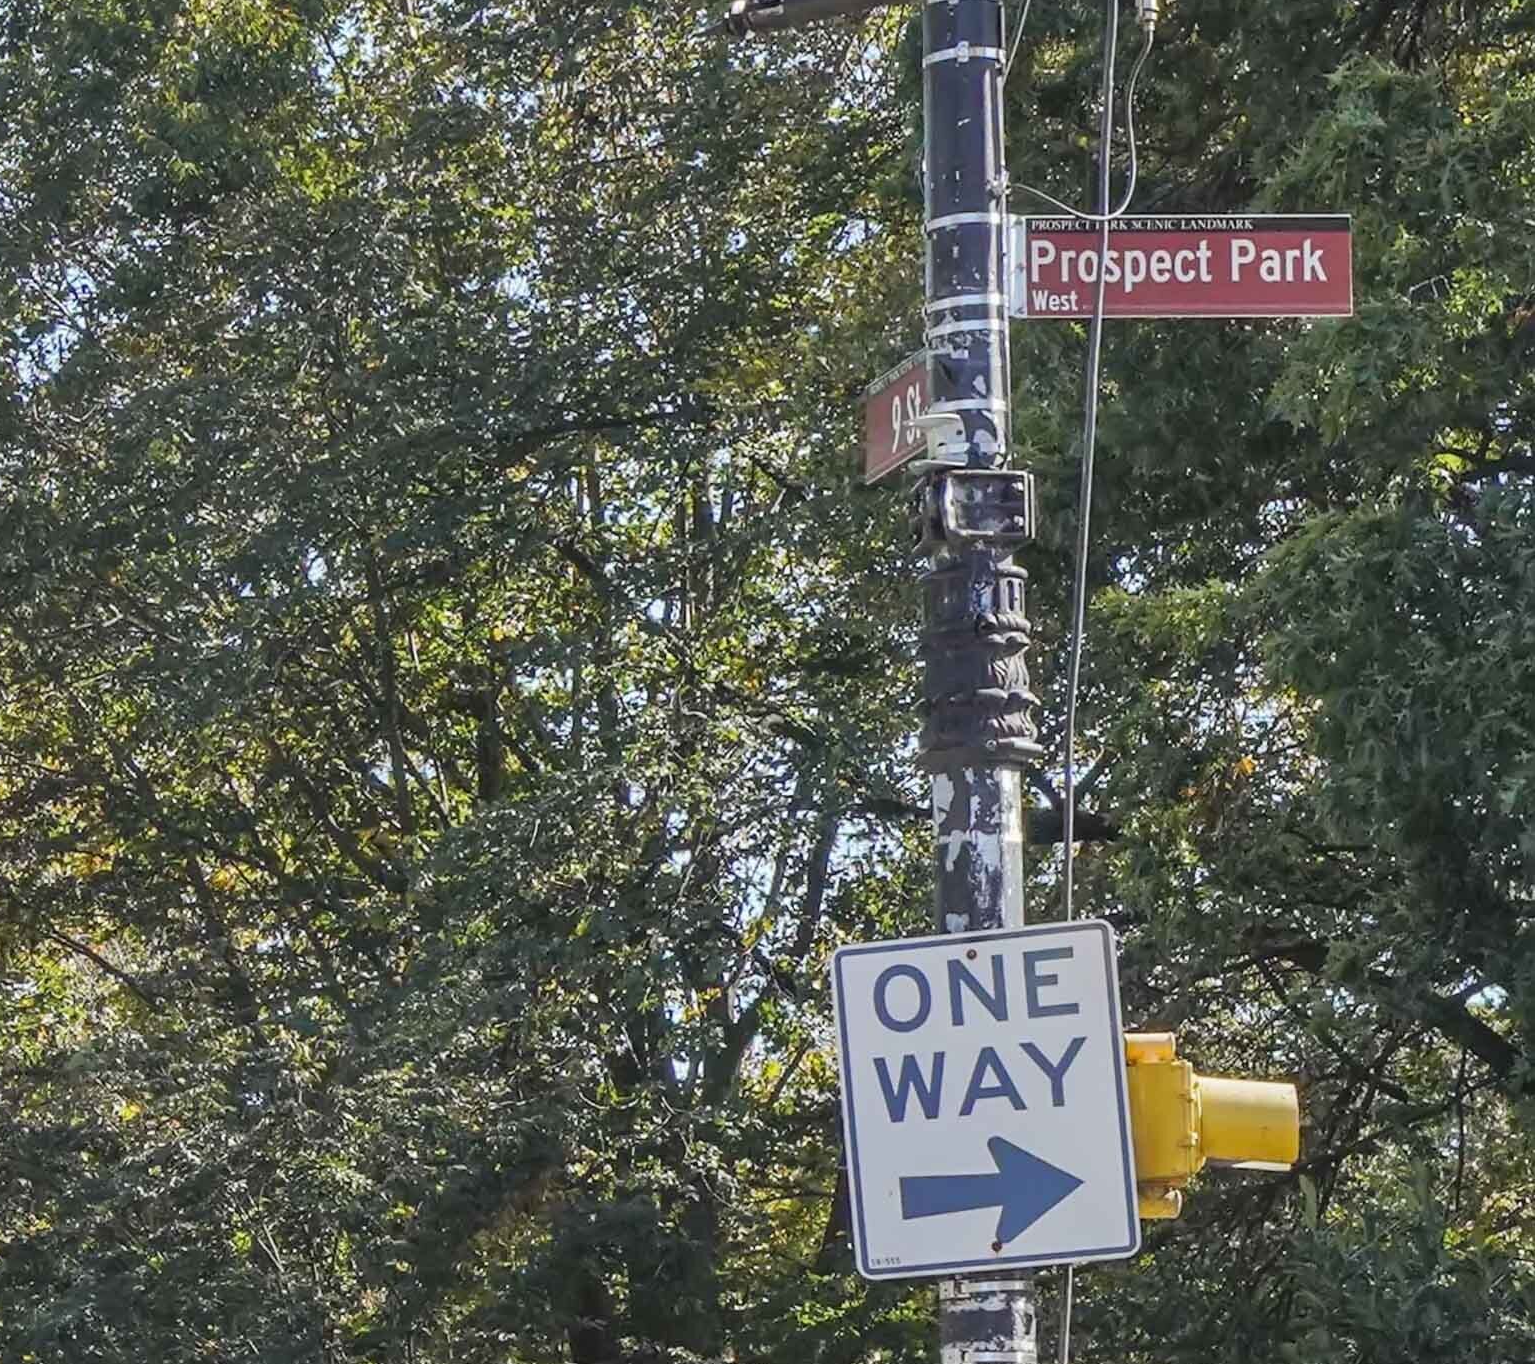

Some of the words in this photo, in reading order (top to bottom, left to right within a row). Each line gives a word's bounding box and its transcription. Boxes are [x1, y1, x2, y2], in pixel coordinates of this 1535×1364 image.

[1031, 219, 1091, 231] PROSPECT
[1131, 219, 1178, 231] SCENIC
[1181, 219, 1254, 231] LANDMARK
[1031, 238, 1212, 293] Prospect
[1230, 238, 1328, 283] Park
[1032, 290, 1079, 312] West
[891, 395, 901, 453] 9
[872, 946, 1081, 1033] ONE
[873, 1036, 1088, 1123] WAY
